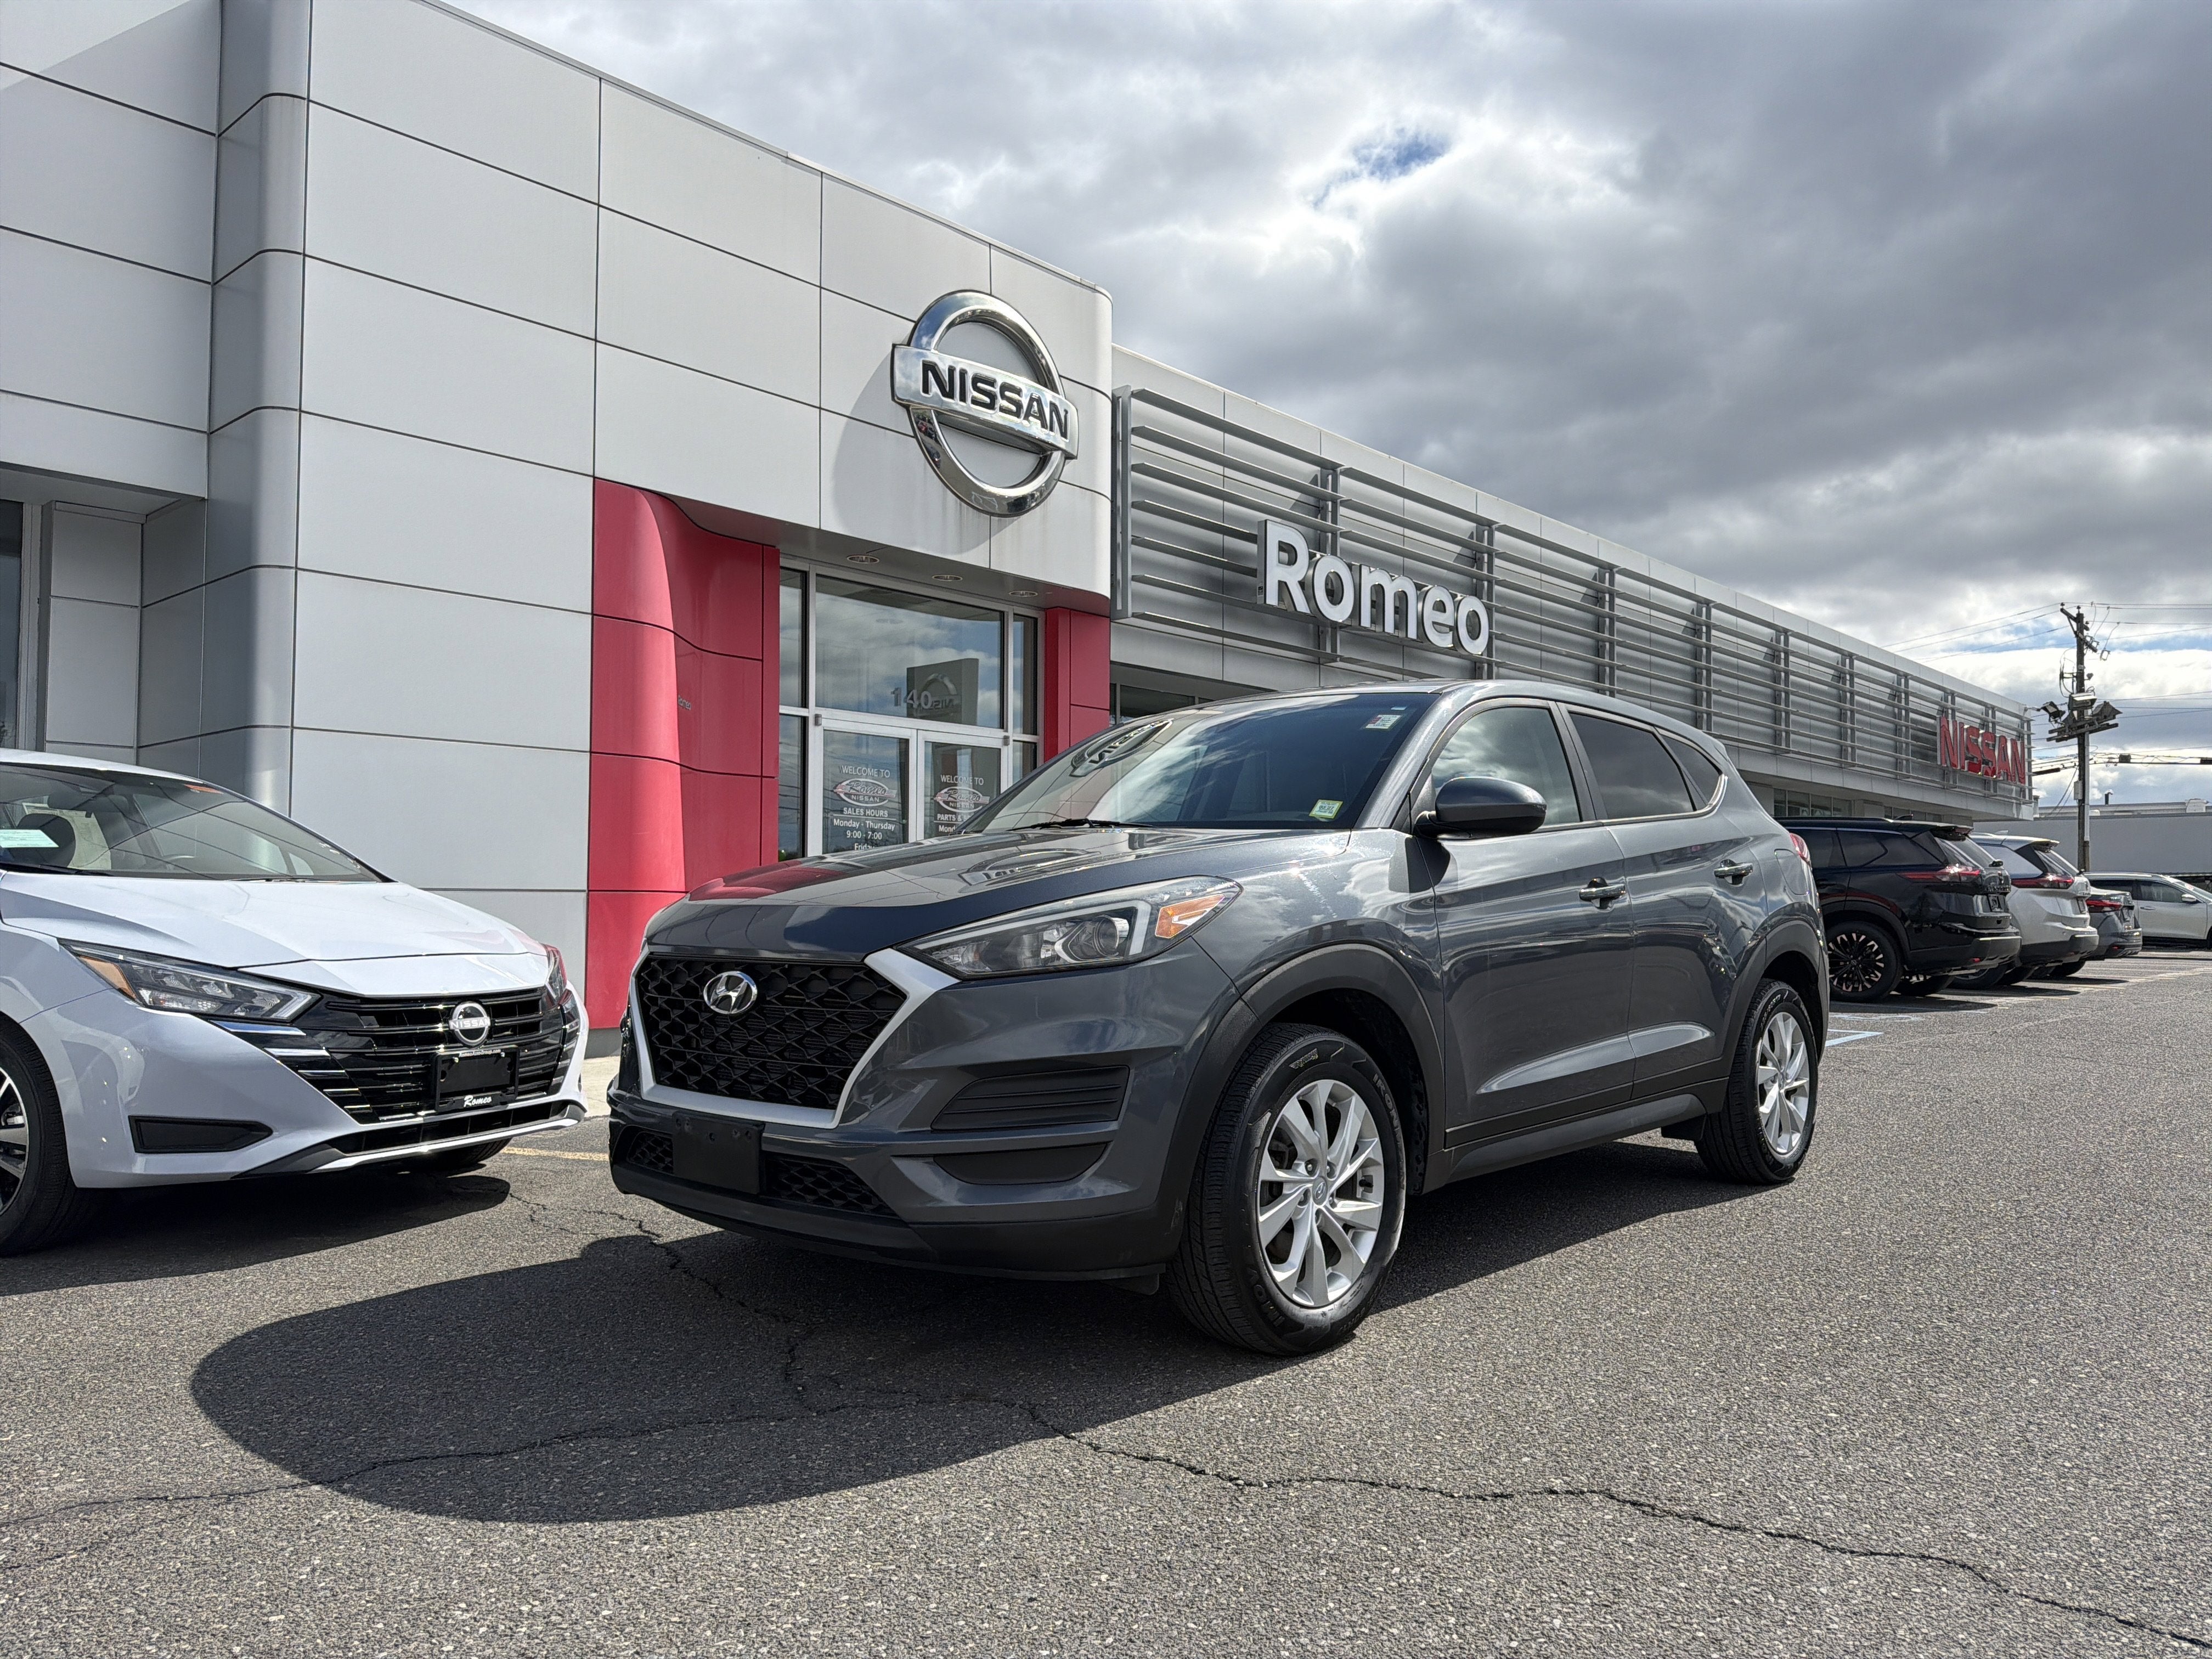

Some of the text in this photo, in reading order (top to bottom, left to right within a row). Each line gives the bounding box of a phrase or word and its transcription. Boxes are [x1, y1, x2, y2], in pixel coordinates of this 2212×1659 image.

[921, 359, 1069, 442] NISSAN
[1257, 519, 1489, 655] Romeo
[891, 687, 933, 709] 140
[1938, 716, 2026, 786] NISSAN
[842, 765, 890, 778] WELCOME TO
[940, 774, 984, 786] WELCOME TO
[848, 780, 887, 795] Romeo
[947, 789, 980, 802] Romeo
[843, 807, 888, 817] SALES HOURS
[937, 813, 956, 821] PARTS
[833, 818, 860, 829] Monday
[865, 820, 895, 831] Thursday
[939, 825, 957, 833] Mond
[846, 830, 862, 839] 9:00
[867, 831, 882, 840] 7:00
[449, 1017, 491, 1030] NISSAN
[463, 1094, 492, 1108] Romeo
